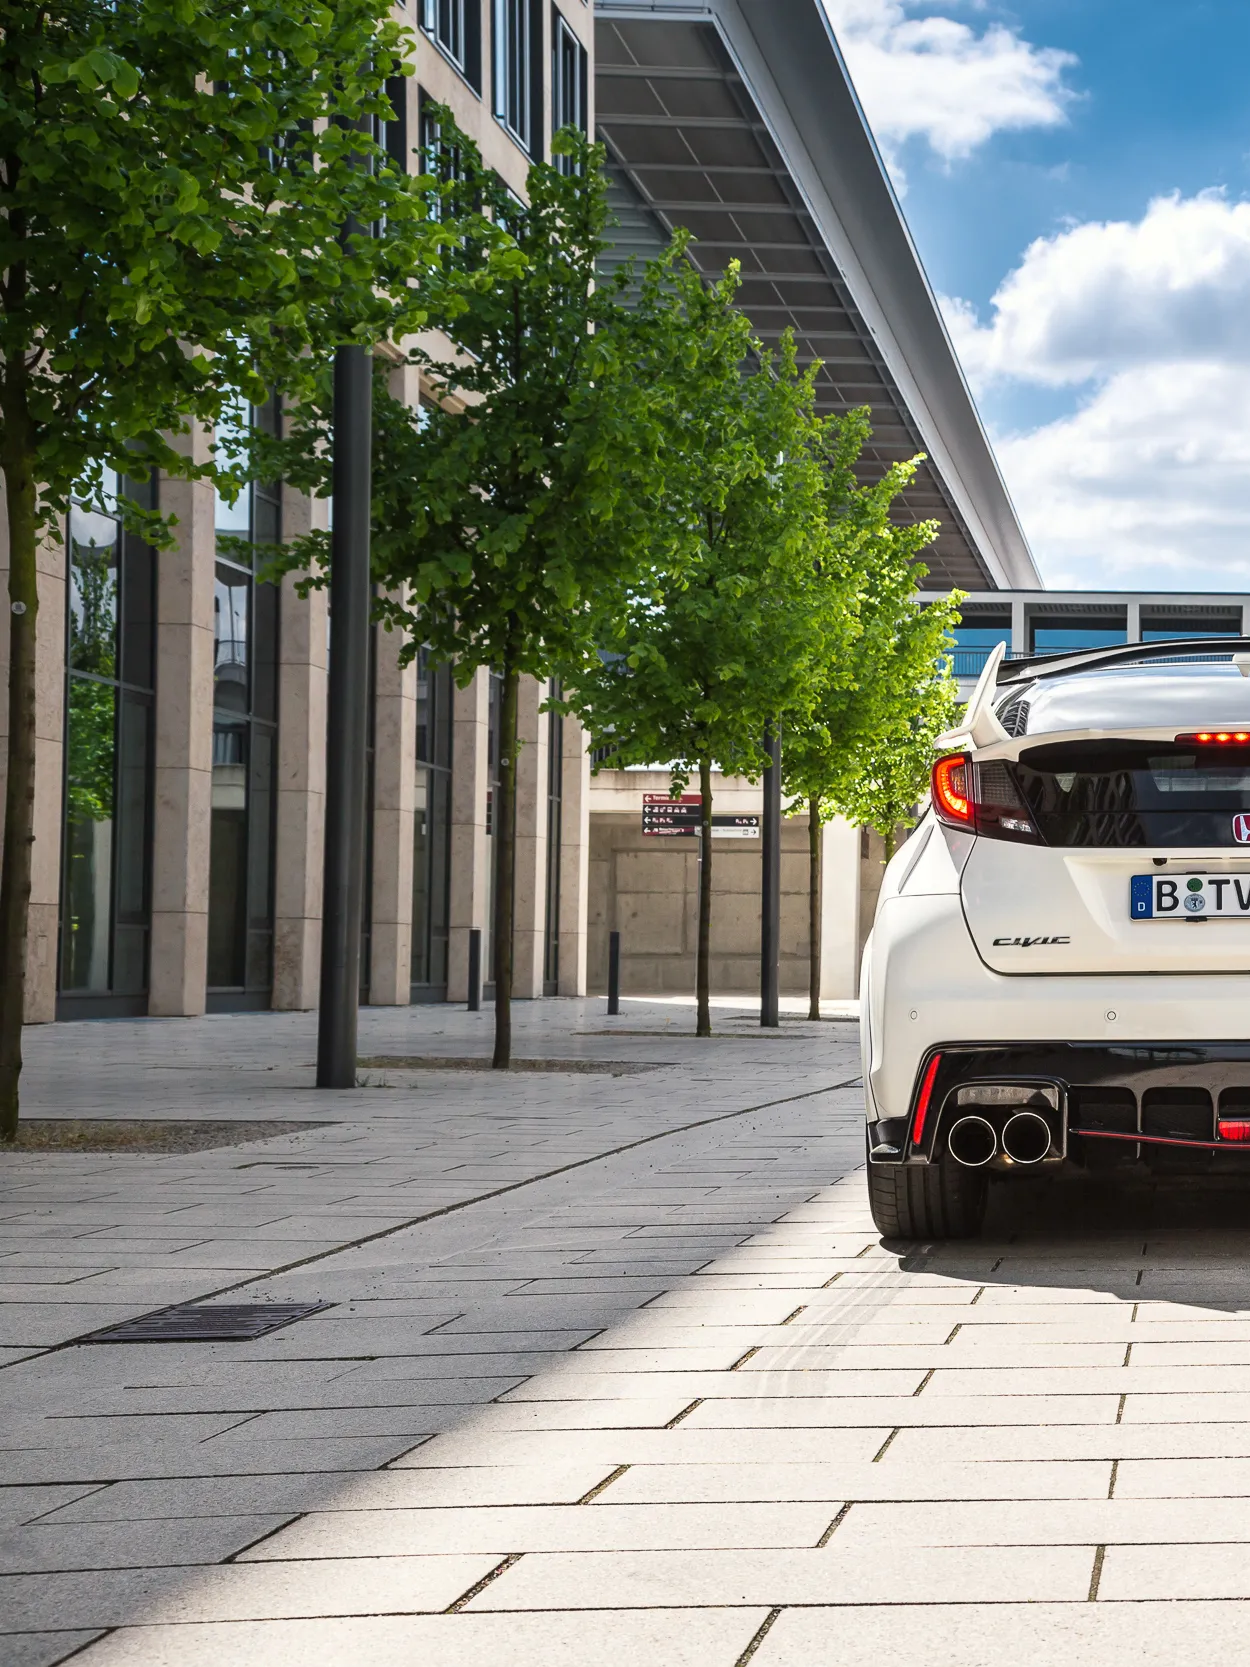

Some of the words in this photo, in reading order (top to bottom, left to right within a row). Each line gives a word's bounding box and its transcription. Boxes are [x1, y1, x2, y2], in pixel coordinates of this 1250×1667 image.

[1156, 880, 1180, 912] B
[1137, 901, 1146, 912] D
[992, 936, 1071, 948] CIVIC
